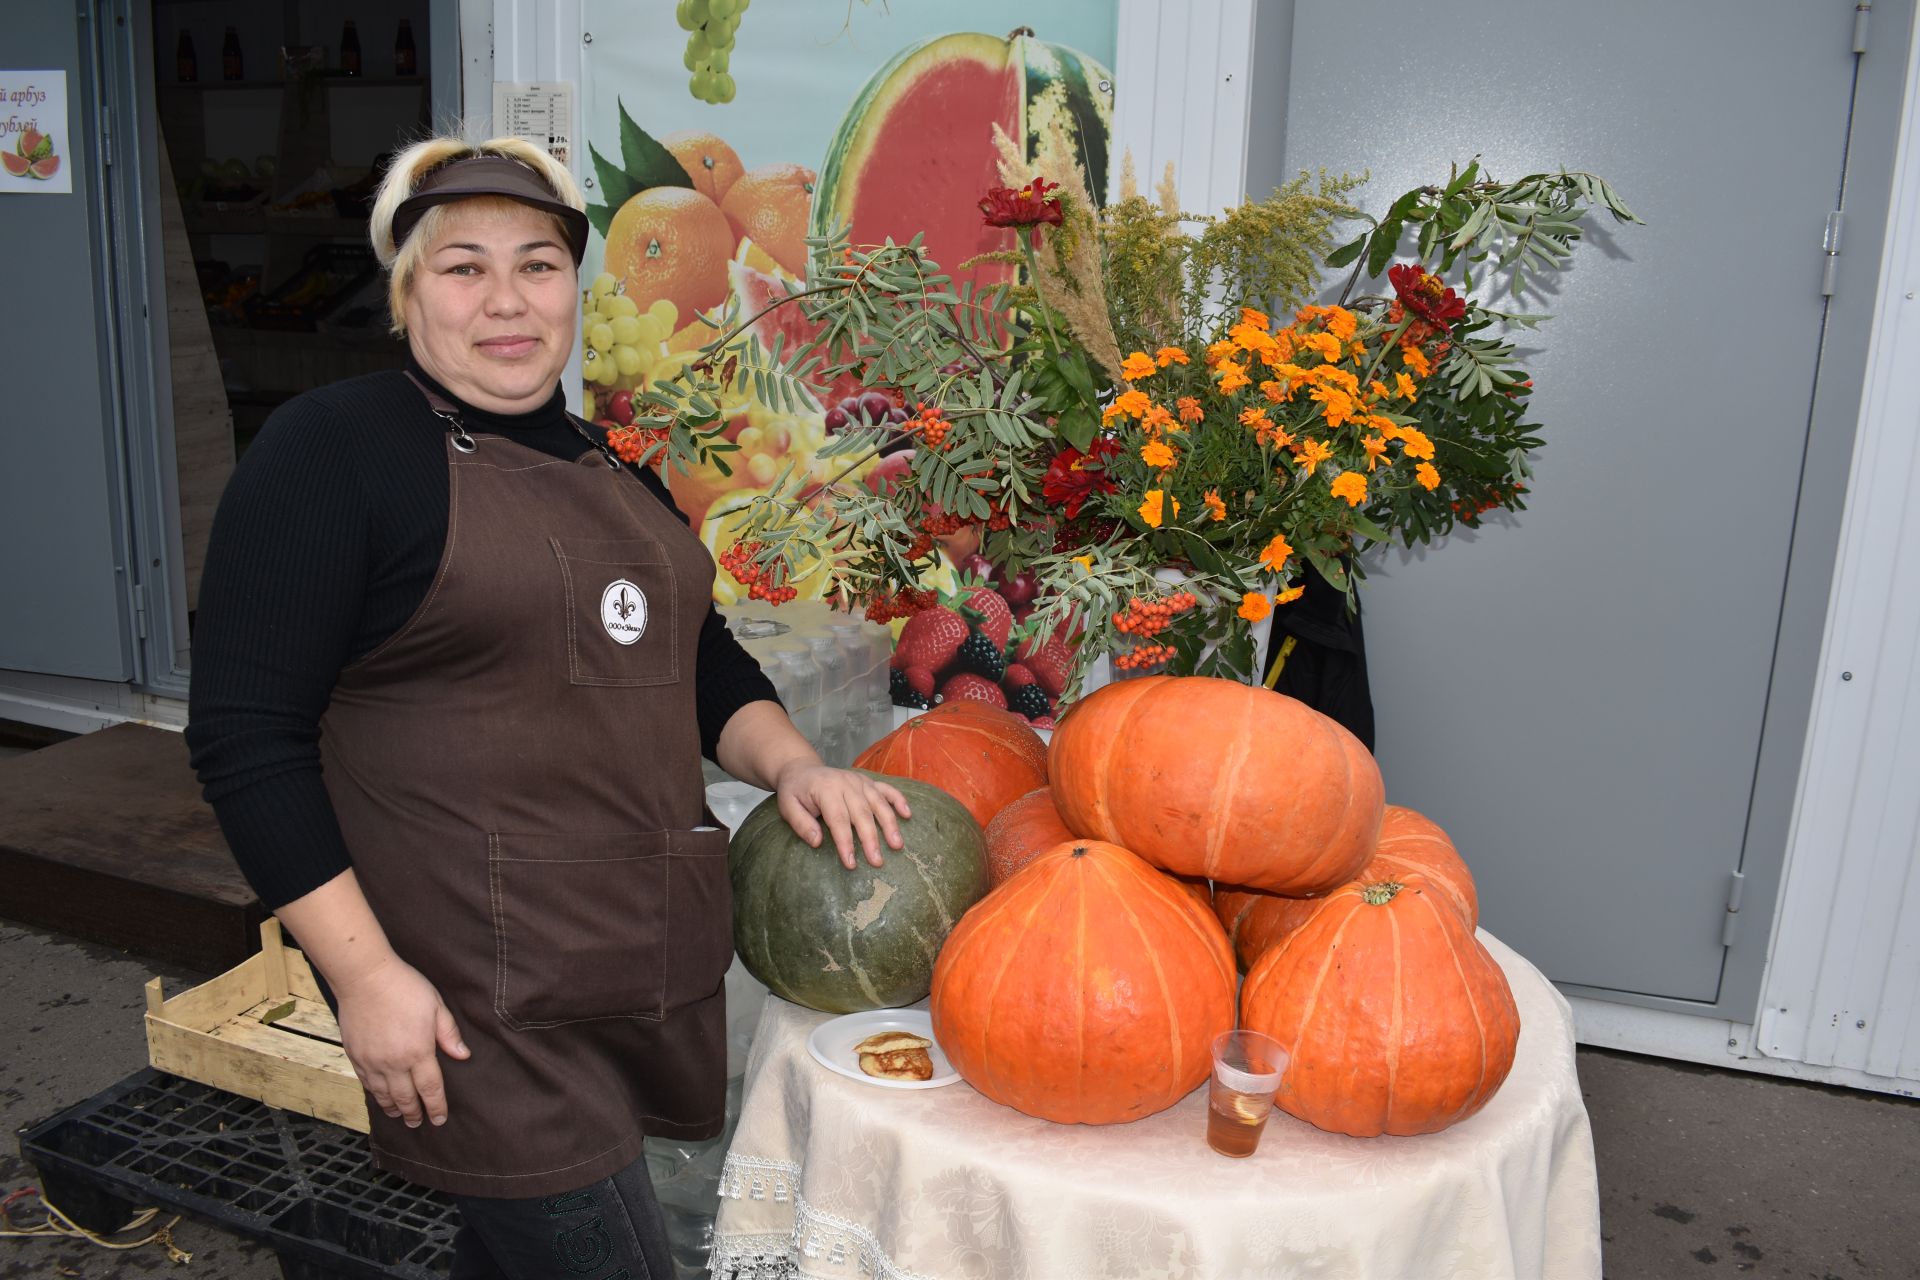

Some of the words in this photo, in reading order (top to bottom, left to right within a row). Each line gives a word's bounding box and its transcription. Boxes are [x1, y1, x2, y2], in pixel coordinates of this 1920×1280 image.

[11, 86, 46, 107] арбуз
[0, 116, 37, 138] ублей
[609, 622, 621, 630] ООО
